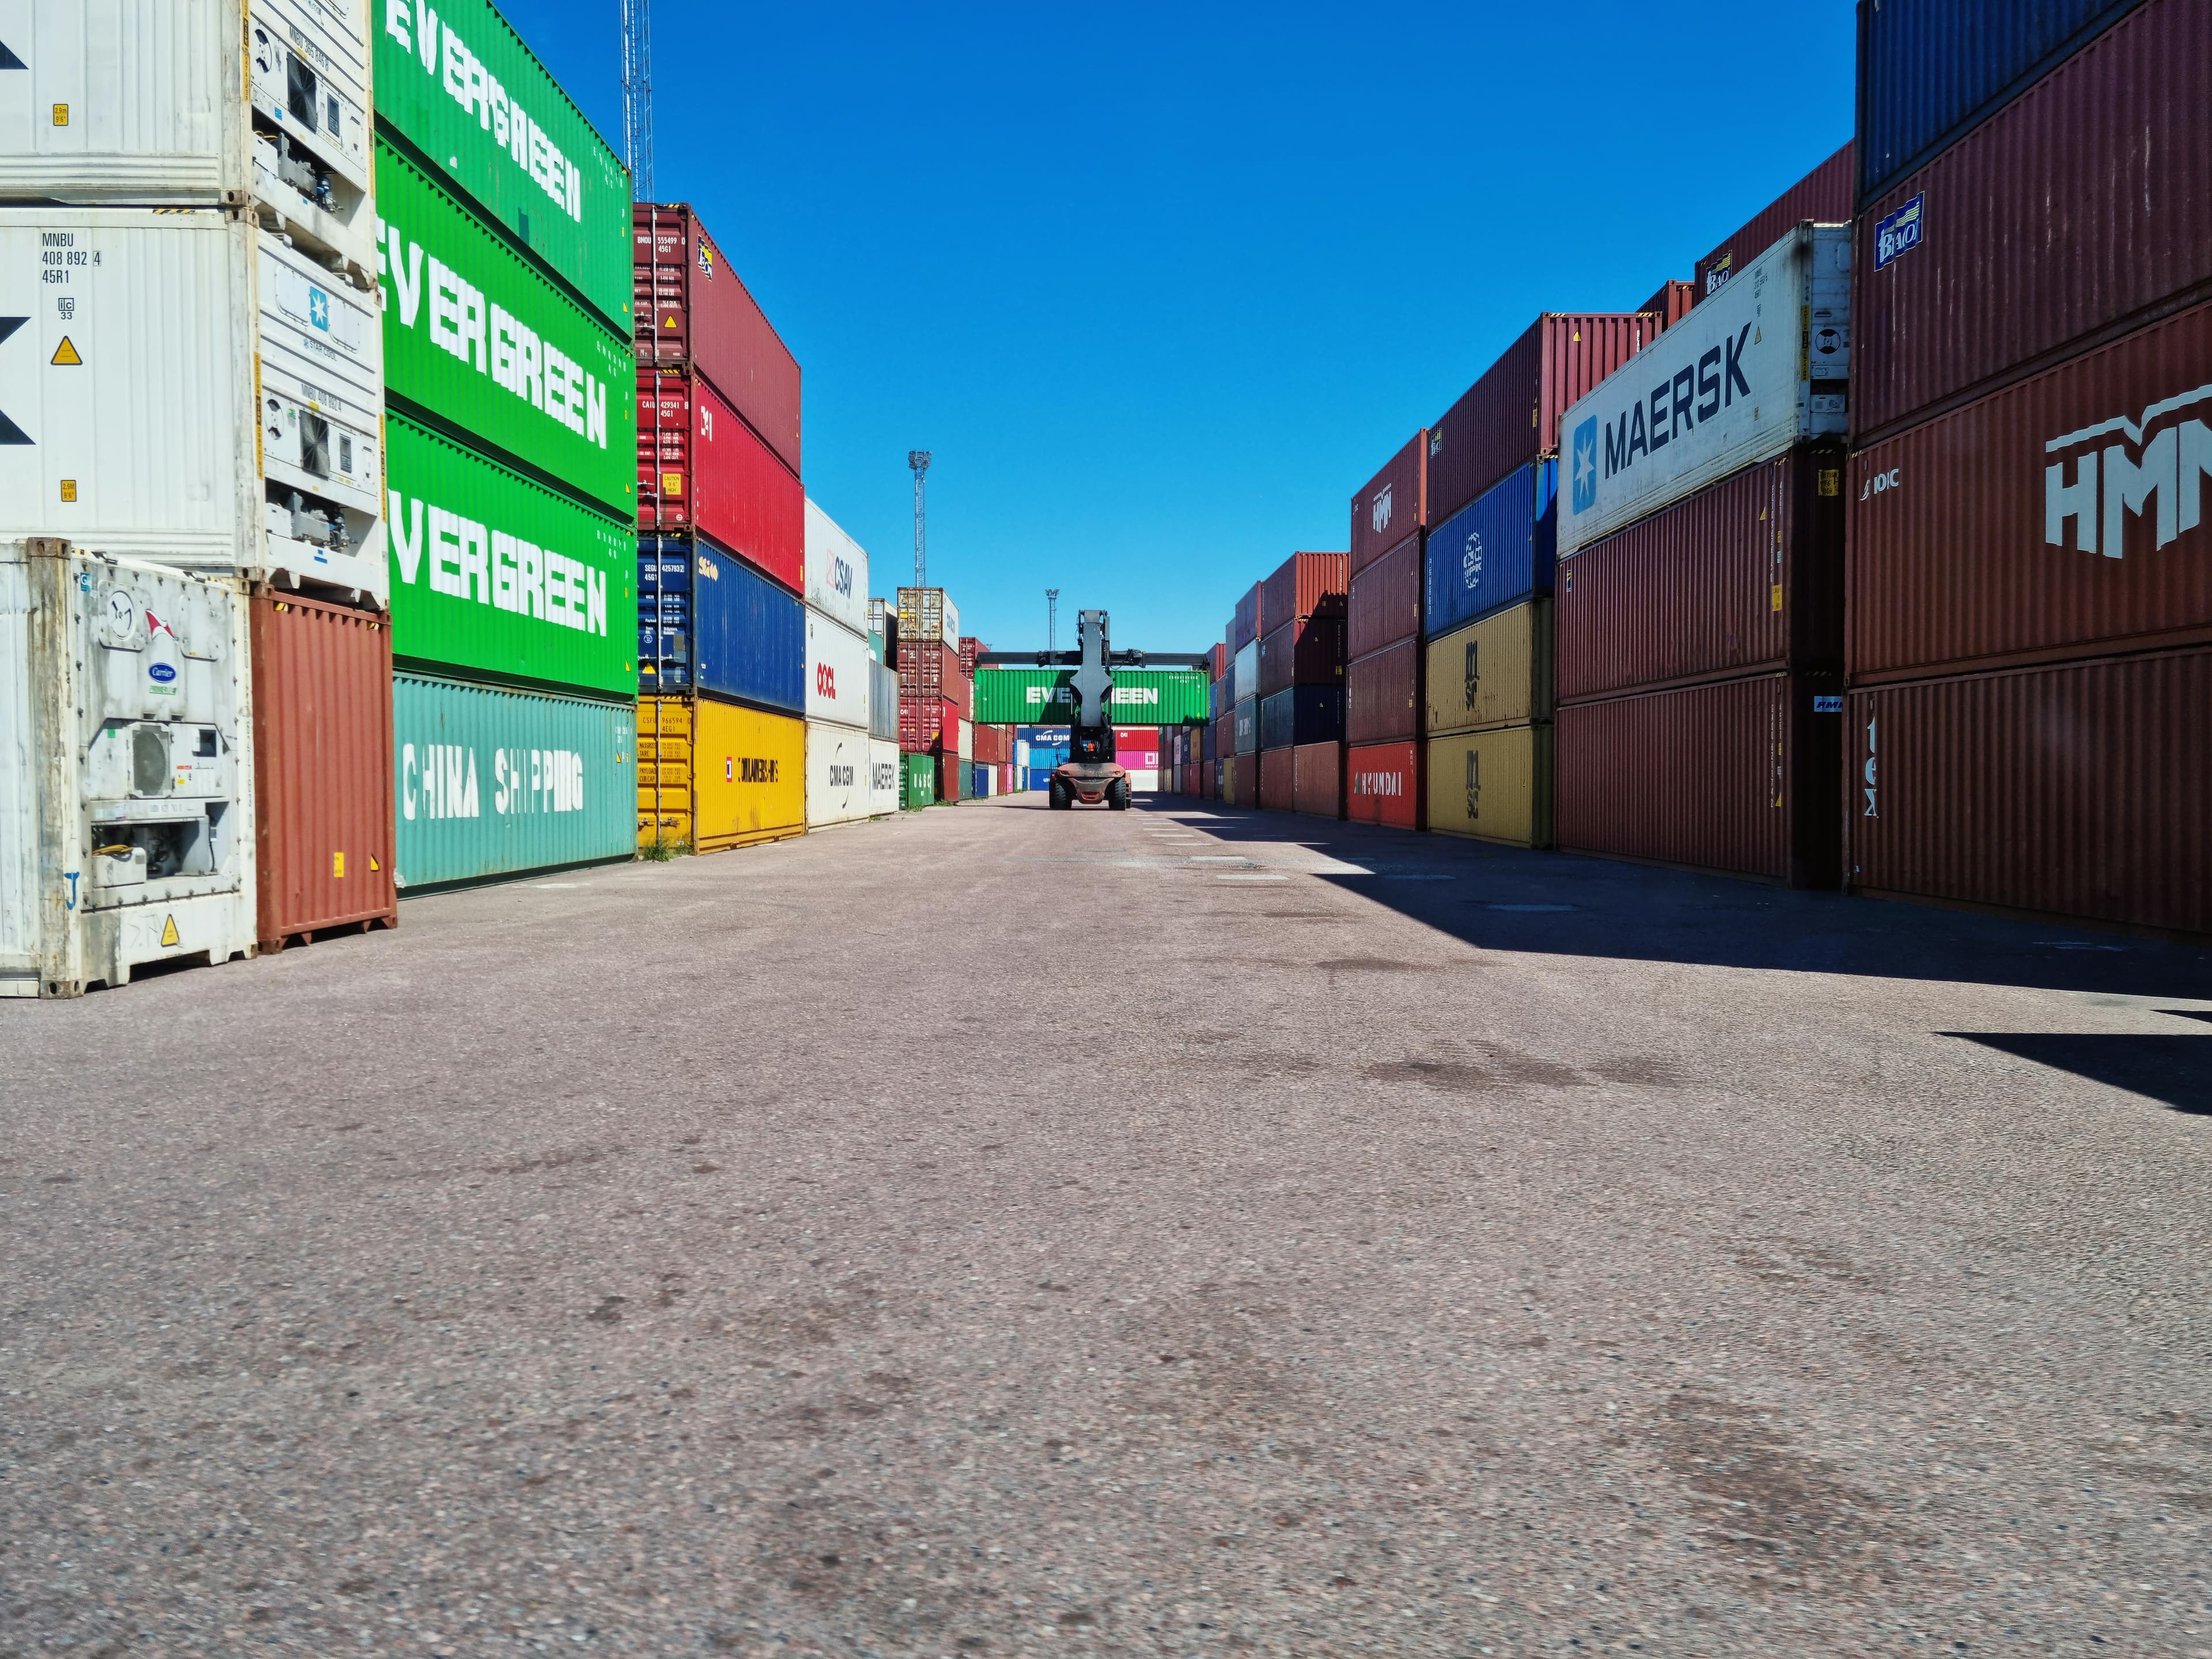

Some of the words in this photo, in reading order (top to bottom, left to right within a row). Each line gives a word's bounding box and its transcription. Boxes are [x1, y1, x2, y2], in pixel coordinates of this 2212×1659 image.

[289, 26, 303, 48] MNBU
[387, 0, 581, 224] EVERGREEN
[42, 233, 74, 247] MNBU
[637, 236, 652, 244] BMOU
[42, 251, 62, 265] 408
[67, 251, 87, 265] 892
[94, 252, 101, 265] 4
[42, 270, 69, 283] 45R1
[60, 312, 72, 320] 33
[1605, 321, 1752, 479] MAERSK
[835, 556, 853, 599] CSAV
[151, 666, 173, 678] Carrier
[817, 662, 835, 699] OOCL
[1027, 687, 1158, 704] EVEEEN
[738, 756, 778, 783] ONTAINERSHIPS
[830, 765, 842, 786] CMA
[843, 766, 854, 786] CGM
[872, 763, 895, 790] MAERSK
[403, 743, 479, 821] CHINA
[495, 747, 584, 816] SHIPPING
[1362, 772, 1402, 796] HYUNDAI
